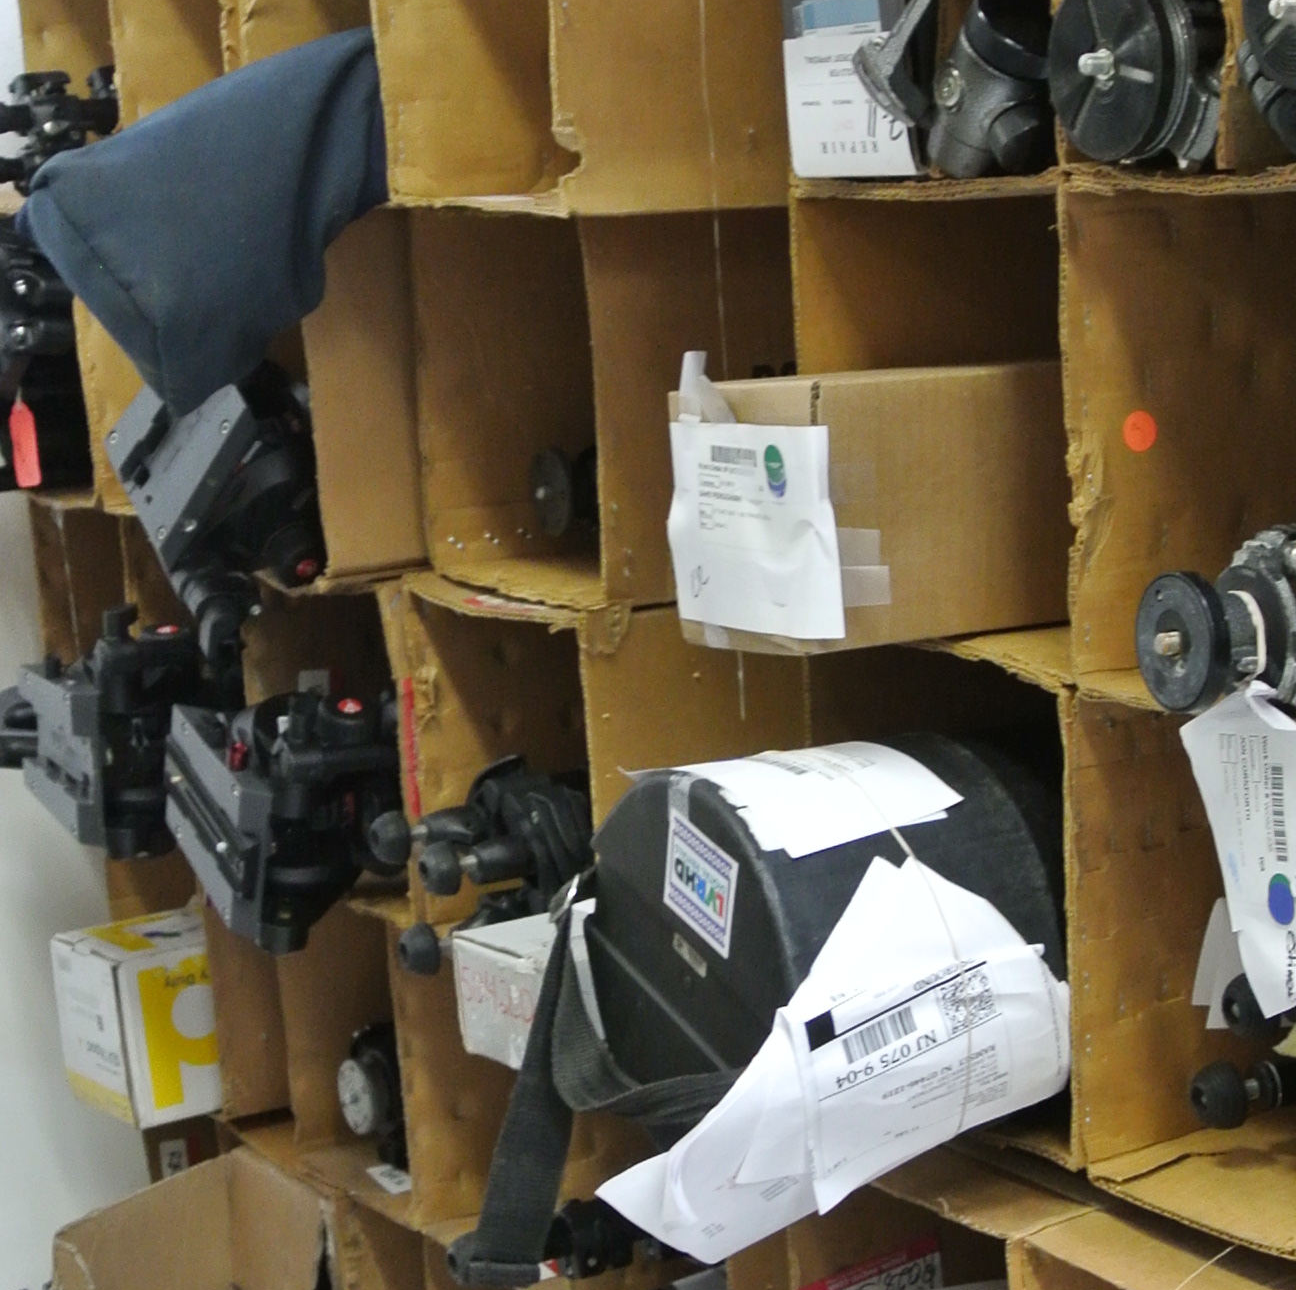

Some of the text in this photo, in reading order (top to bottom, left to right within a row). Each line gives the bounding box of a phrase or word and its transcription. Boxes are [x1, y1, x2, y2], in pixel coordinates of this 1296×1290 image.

[834, 1028, 938, 1089] NJ 075 9-04
